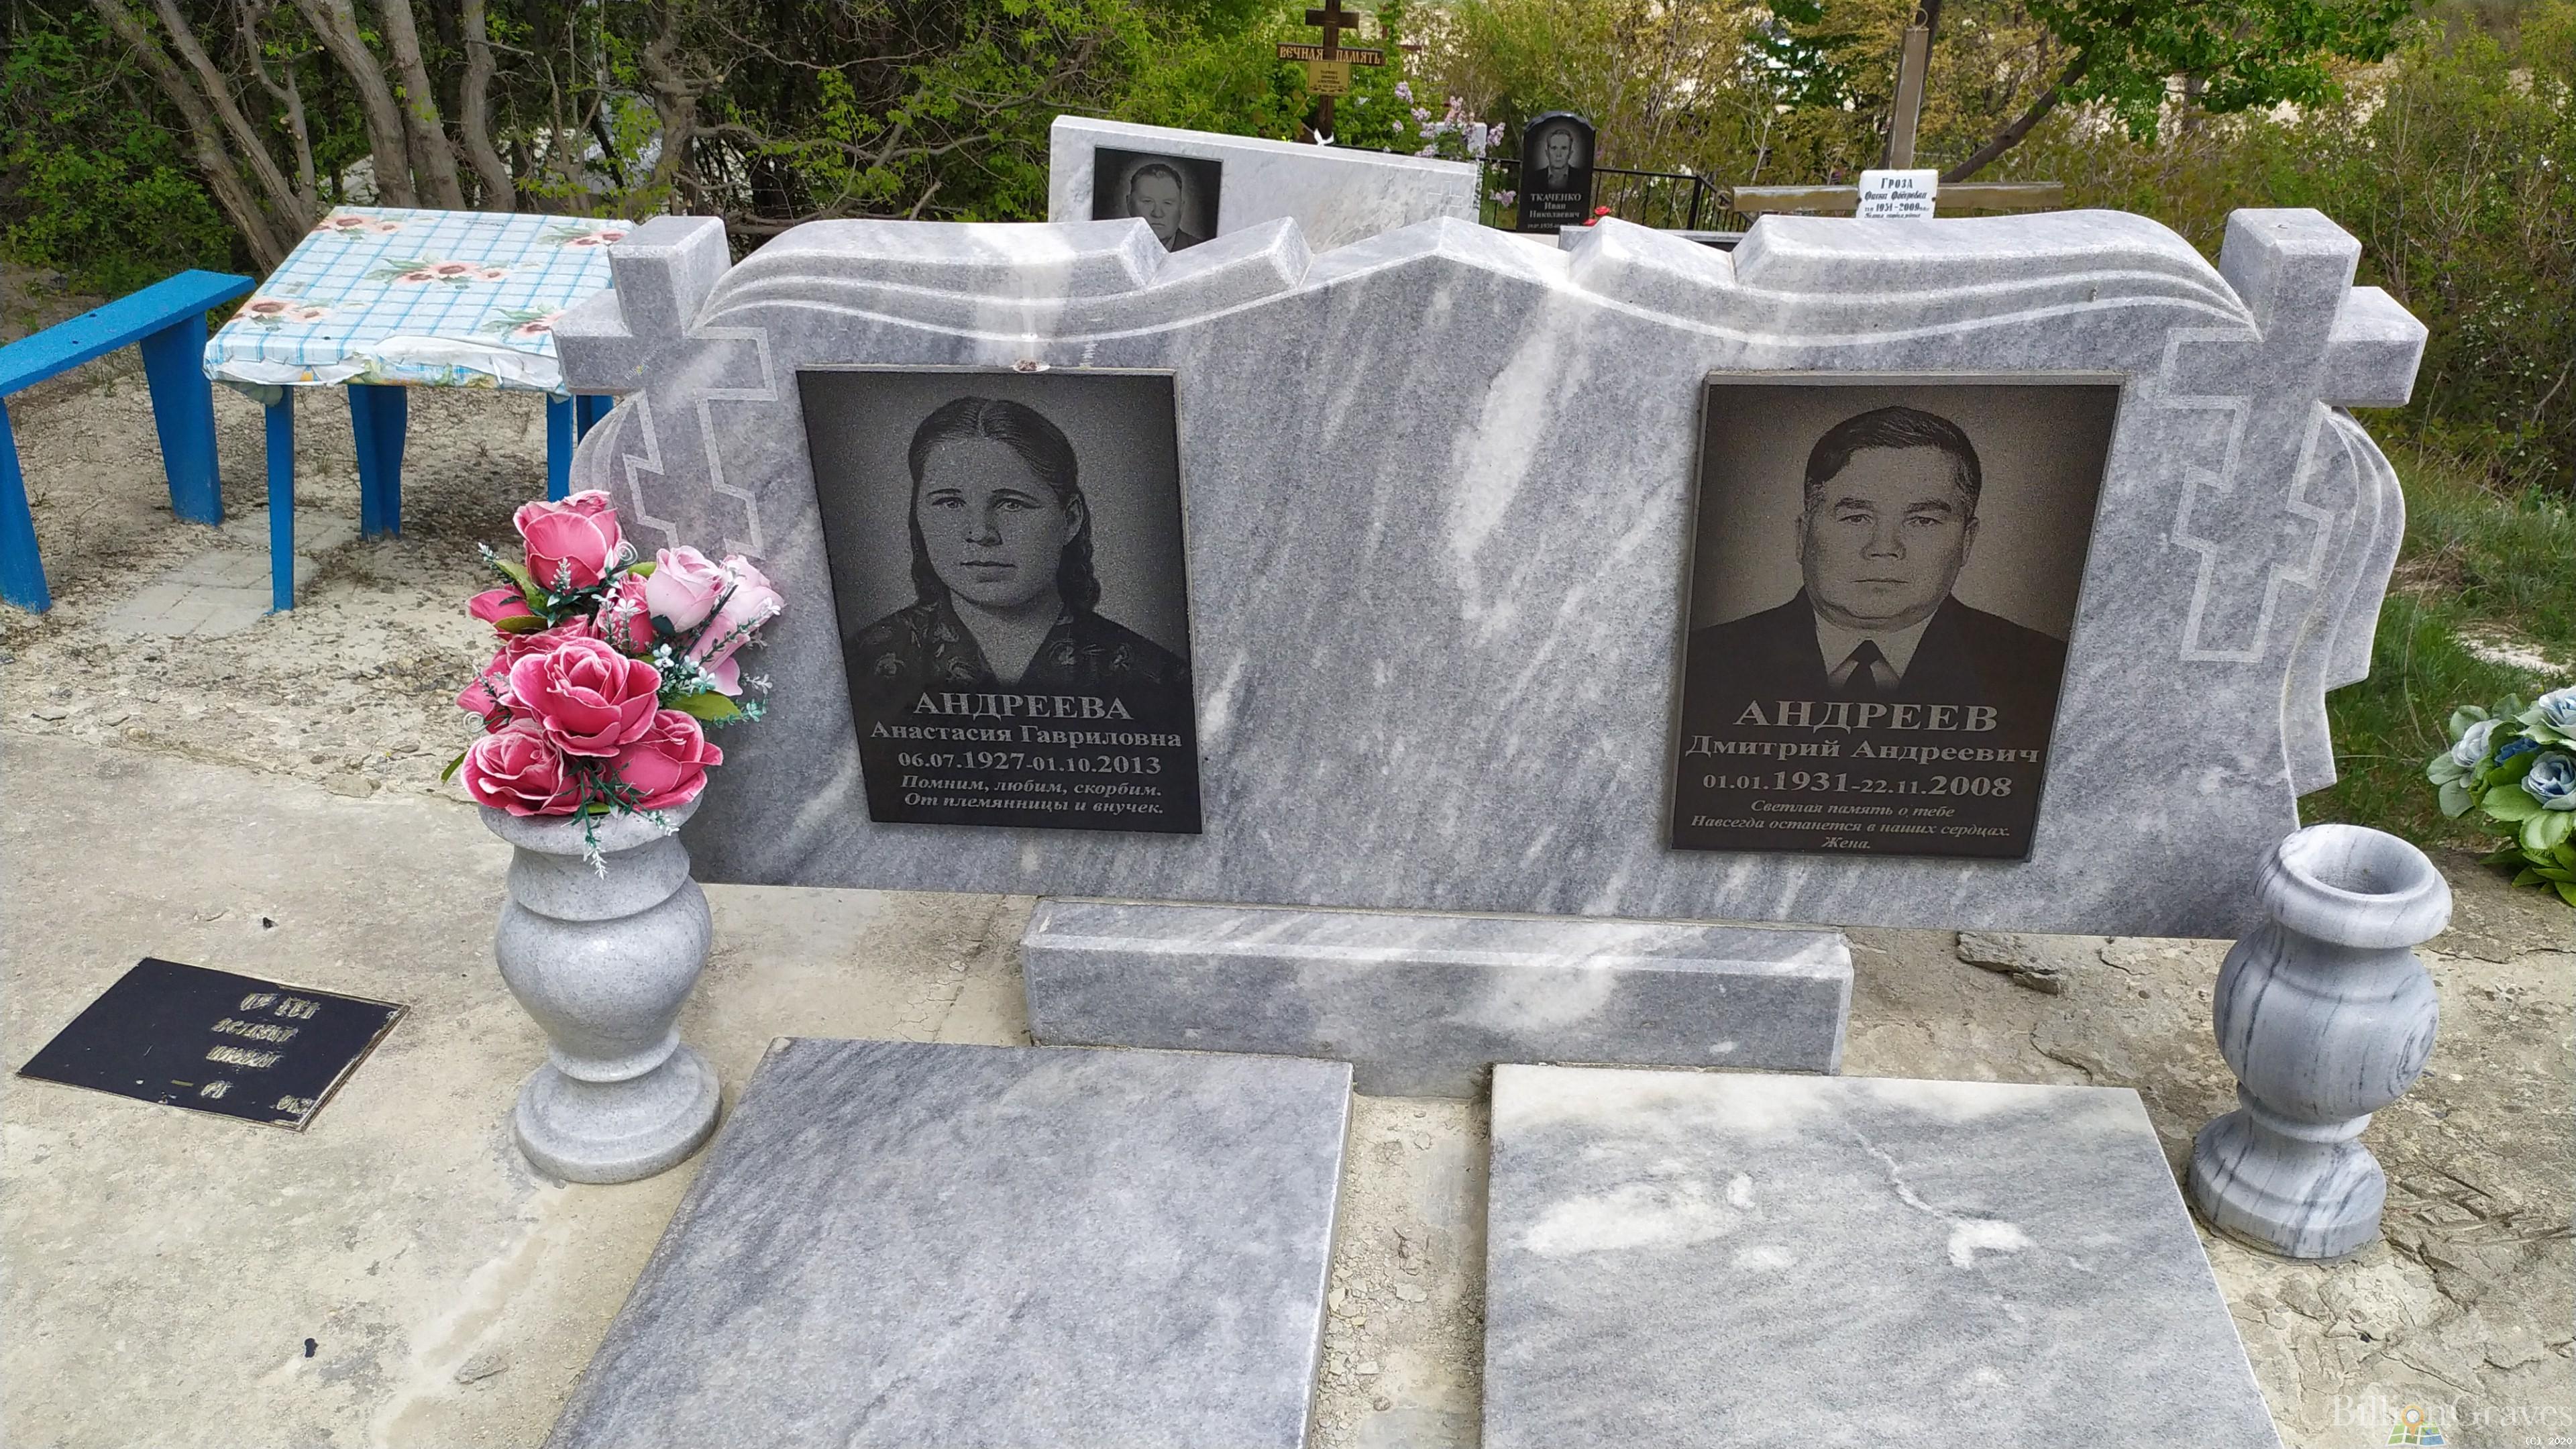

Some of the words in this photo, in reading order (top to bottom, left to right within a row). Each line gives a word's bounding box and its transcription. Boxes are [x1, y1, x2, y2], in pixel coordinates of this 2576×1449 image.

[1279, 47, 1324, 60] ВЕЧНАЯ
[1336, 50, 1381, 64] ПАМЯТЬ
[1880, 178, 1913, 189] ГРОЗА
[1530, 193, 1582, 201] ТКАЧЕНКО
[1544, 202, 1566, 210] Иван
[1529, 210, 1580, 218] Николаевич
[913, 692, 1134, 722] АНДРЕЕВА
[1733, 699, 1998, 734] АНДРЕЕВ
[870, 720, 1013, 742] Анастасия
[1019, 724, 1182, 749] Гавриловна
[1685, 735, 1840, 761] Дмитрий
[1850, 741, 2040, 765] Андреевич
[898, 751, 1162, 774] 06.07.1927-01.10.2013
[900, 775, 989, 792] Помним,
[994, 780, 1067, 795] любим,
[1074, 782, 1162, 798] скорбим.
[1703, 771, 2013, 797] 01.01.1931-22.11.2008
[904, 792, 938, 806] От
[943, 796, 1069, 812] племянницы
[1075, 801, 1087, 811] и
[1093, 802, 1163, 815] внучек.
[1751, 800, 1822, 813] Светлая
[1827, 805, 1893, 816] память
[1898, 807, 1908, 816] о
[1913, 806, 1955, 817] тебе
[1691, 815, 1765, 828] Навсегда
[1769, 820, 1862, 833] останется
[1867, 824, 1876, 833] в
[1880, 823, 1937, 834] наших
[1941, 824, 2010, 837] сердцах.
[1821, 837, 1871, 849] Жена.
